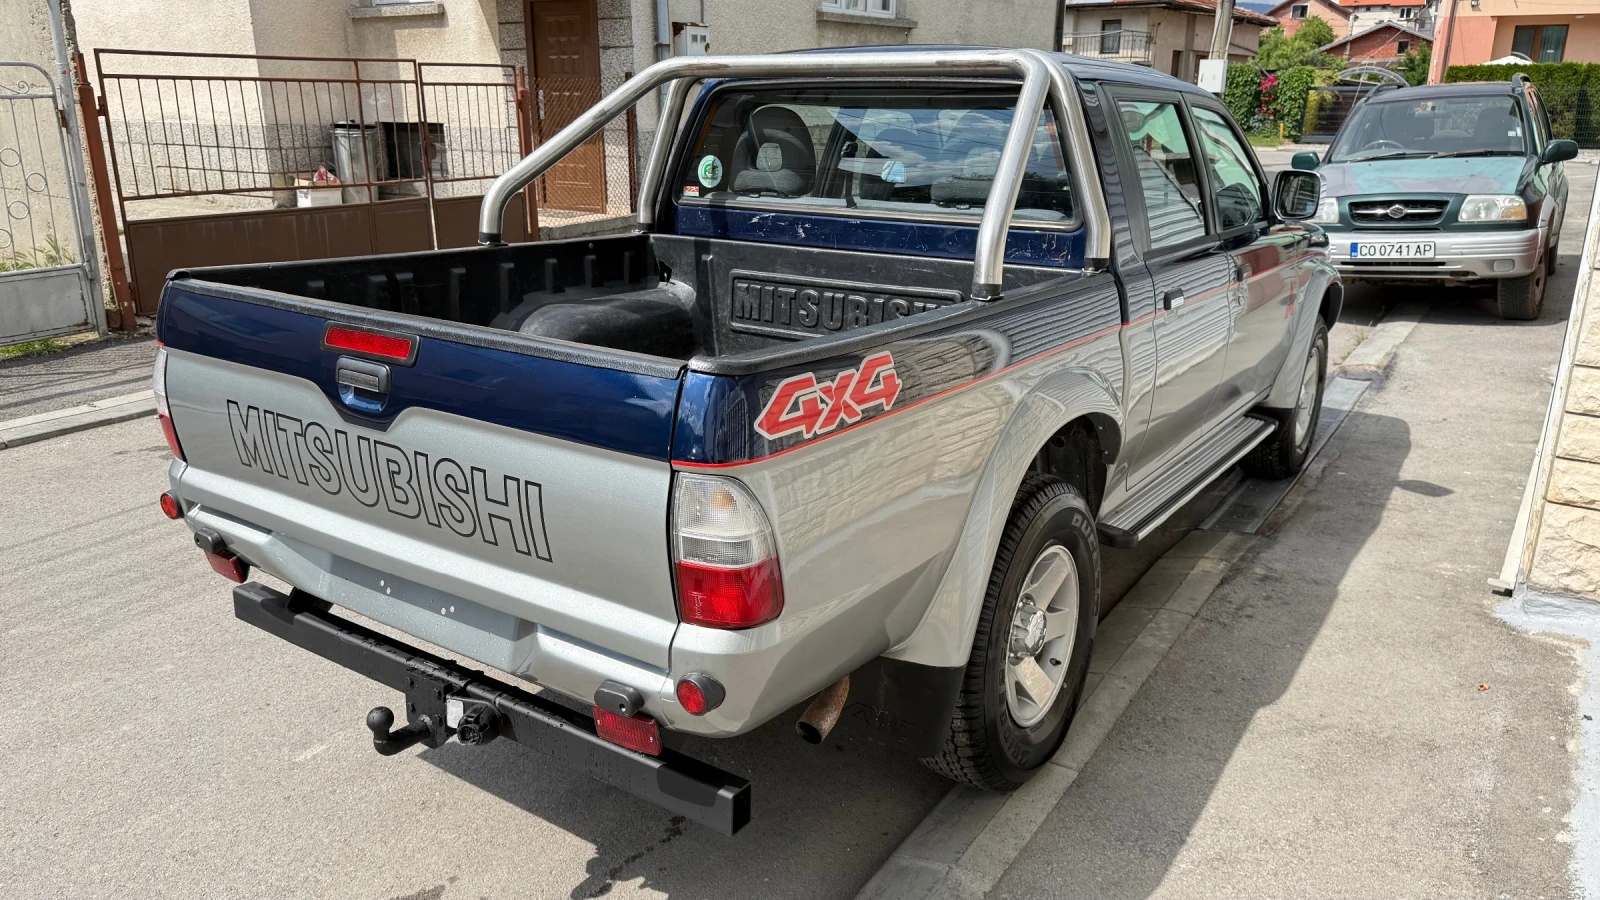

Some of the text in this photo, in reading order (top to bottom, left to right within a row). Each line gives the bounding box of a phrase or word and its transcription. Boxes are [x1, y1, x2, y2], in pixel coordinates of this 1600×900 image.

[1359, 243, 1432, 257] CO 0741 AP
[735, 282, 950, 331] MITSUBIS
[227, 399, 554, 563] MITSUBISHI
